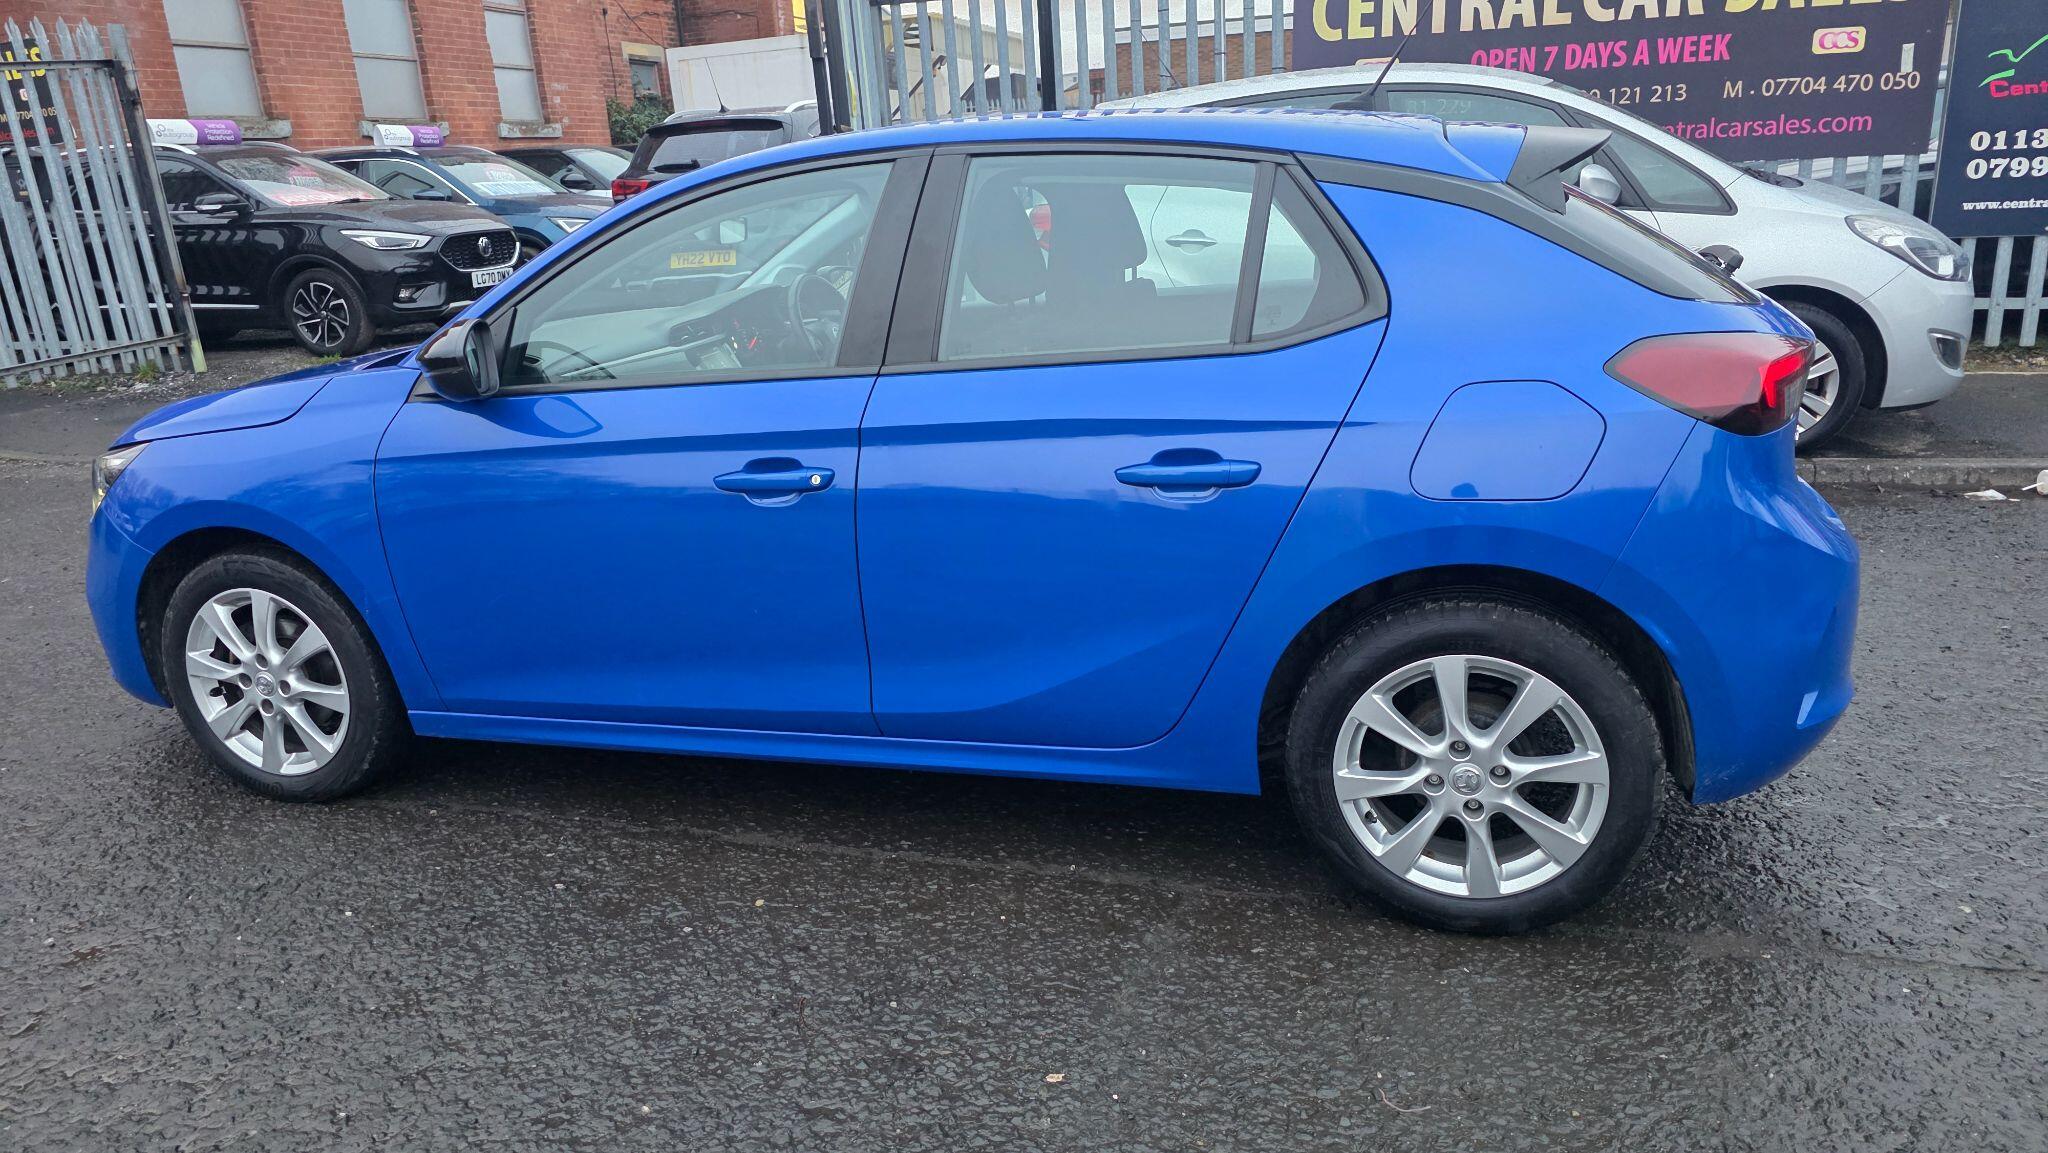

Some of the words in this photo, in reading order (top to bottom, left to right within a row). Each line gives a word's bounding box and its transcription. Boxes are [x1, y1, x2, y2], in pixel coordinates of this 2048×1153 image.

[1818, 31, 1860, 50] CCS
[1471, 46, 1536, 72] OPEN
[1543, 45, 1559, 72] 7
[1565, 40, 1627, 70] DAYS
[1632, 39, 1650, 66] A
[1657, 33, 1732, 64] WEEK
[1609, 86, 1641, 105] 121
[1650, 83, 1687, 103] 213
[1762, 75, 1826, 97] 07704
[1833, 73, 1873, 93] 470
[1880, 71, 1921, 91] 050
[1970, 128, 2048, 151] 0113
[1966, 156, 2048, 180] 0799
[676, 252, 704, 265] YH22
[475, 272, 496, 285] LG70
